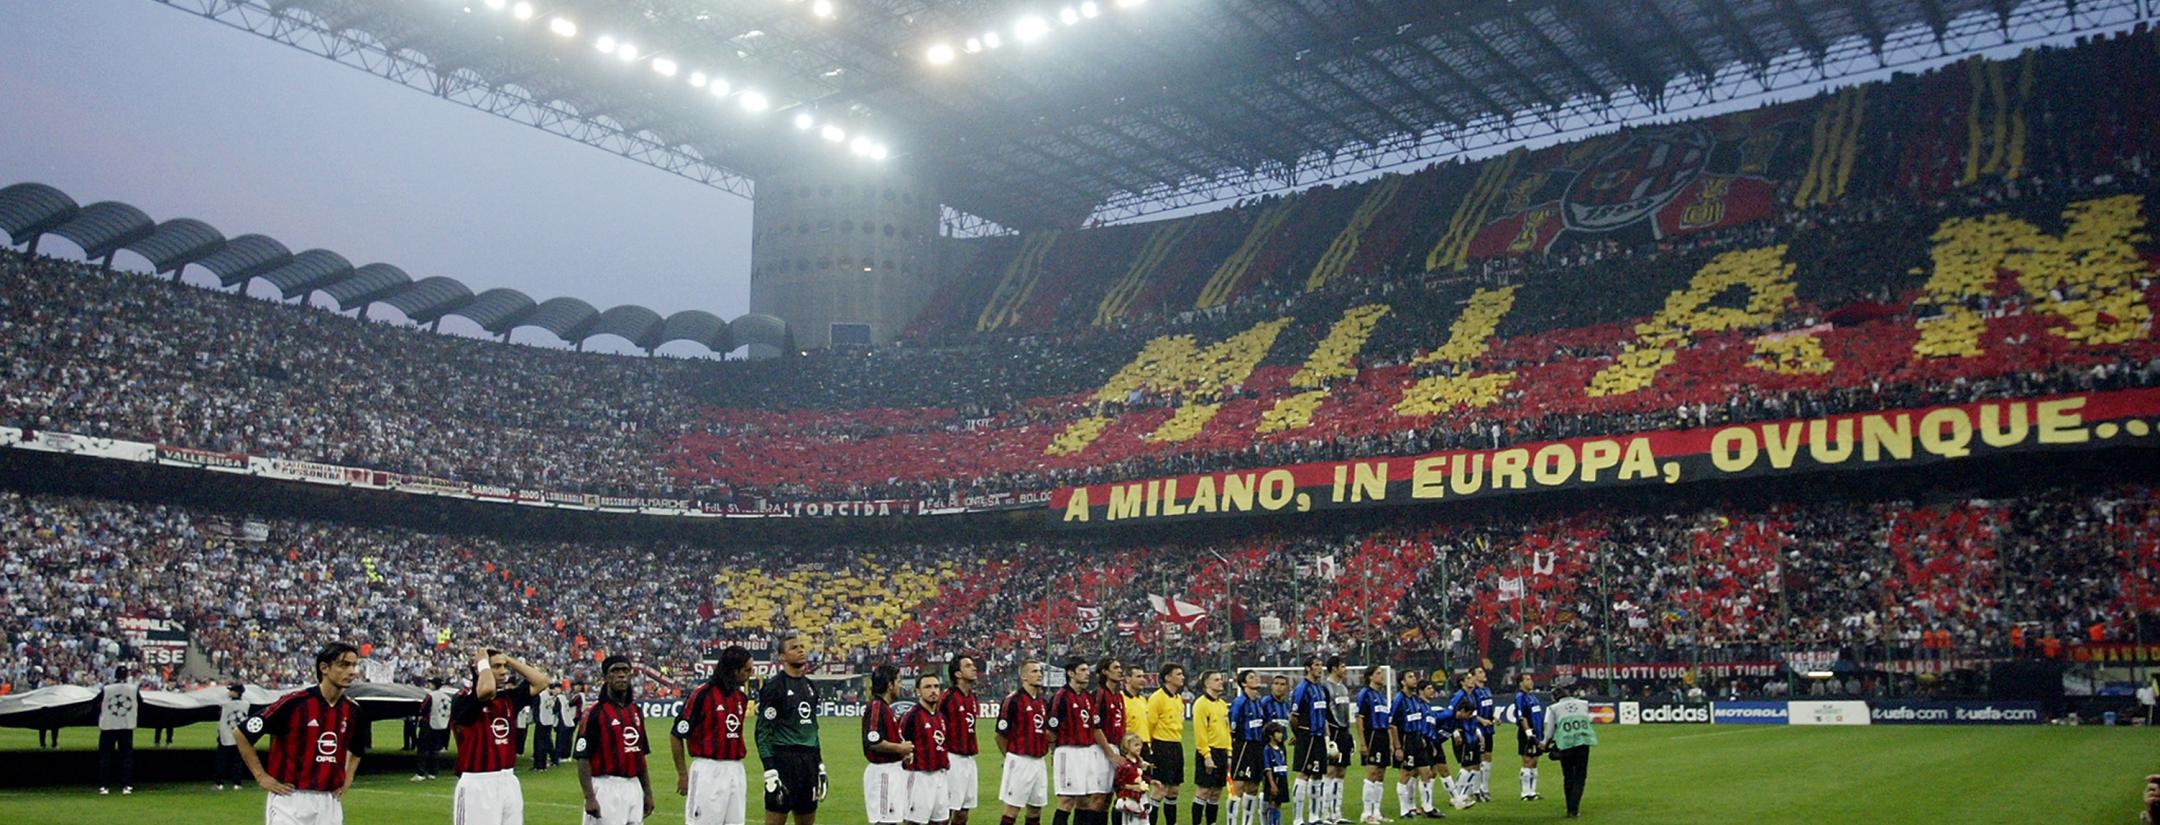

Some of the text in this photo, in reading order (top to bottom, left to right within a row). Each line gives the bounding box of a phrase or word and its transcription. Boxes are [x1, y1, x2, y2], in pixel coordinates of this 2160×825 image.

[1063, 396, 2160, 522] A MILANO, IN EUROPA, OVUNQUE..
[519, 489, 540, 500] 2000
[793, 502, 890, 516] TORCIDA
[1641, 705, 1708, 722] adidas
[1714, 707, 1788, 718] MOTOROLA
